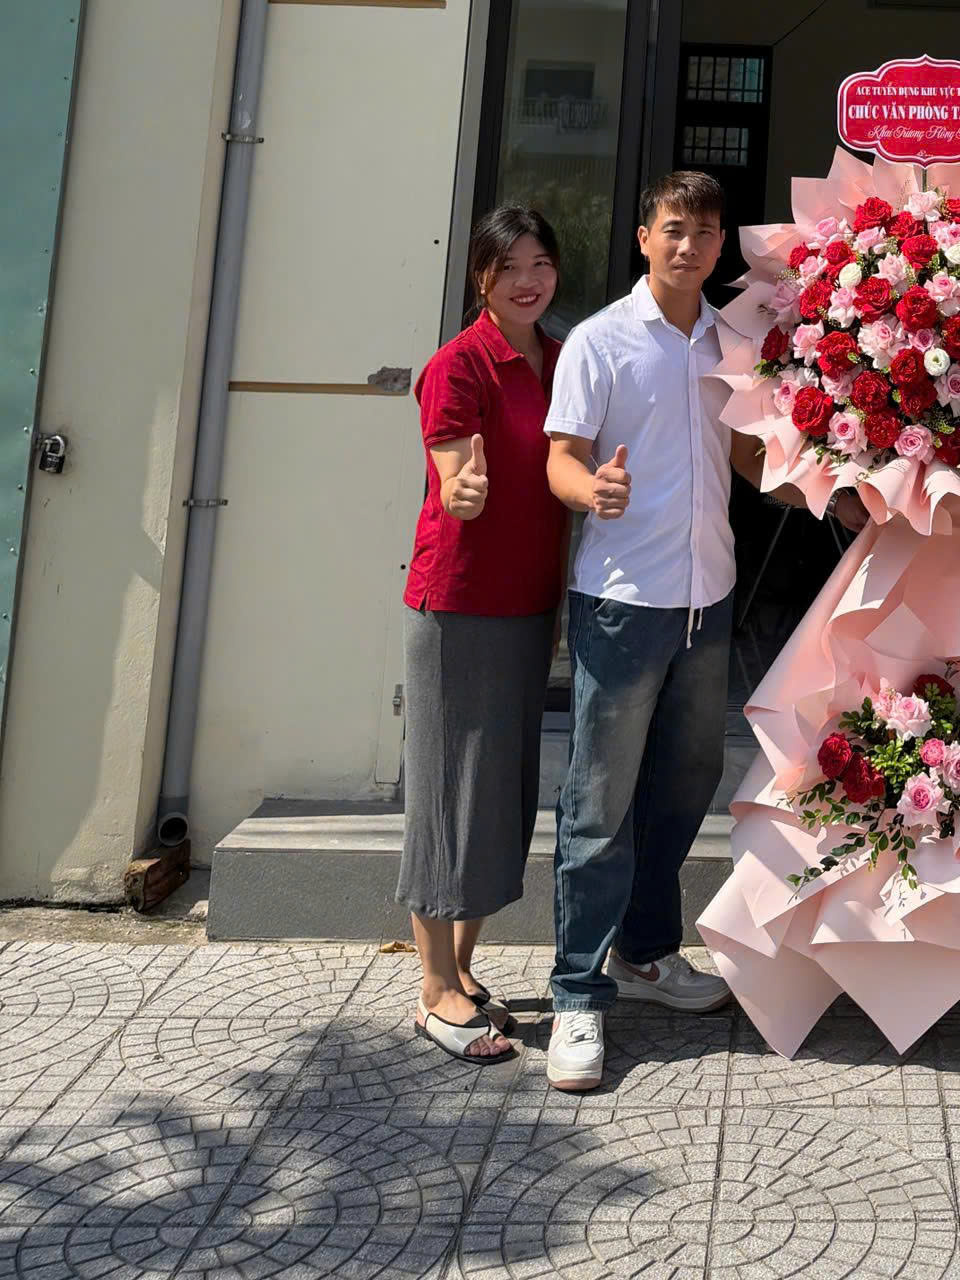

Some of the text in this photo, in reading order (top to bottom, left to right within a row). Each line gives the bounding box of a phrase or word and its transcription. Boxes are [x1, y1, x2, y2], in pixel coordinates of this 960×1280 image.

[921, 87, 937, 96] KHU
[848, 101, 880, 119] CHÚC
[882, 101, 905, 119] VĂN
[908, 101, 948, 120] PHÒNG
